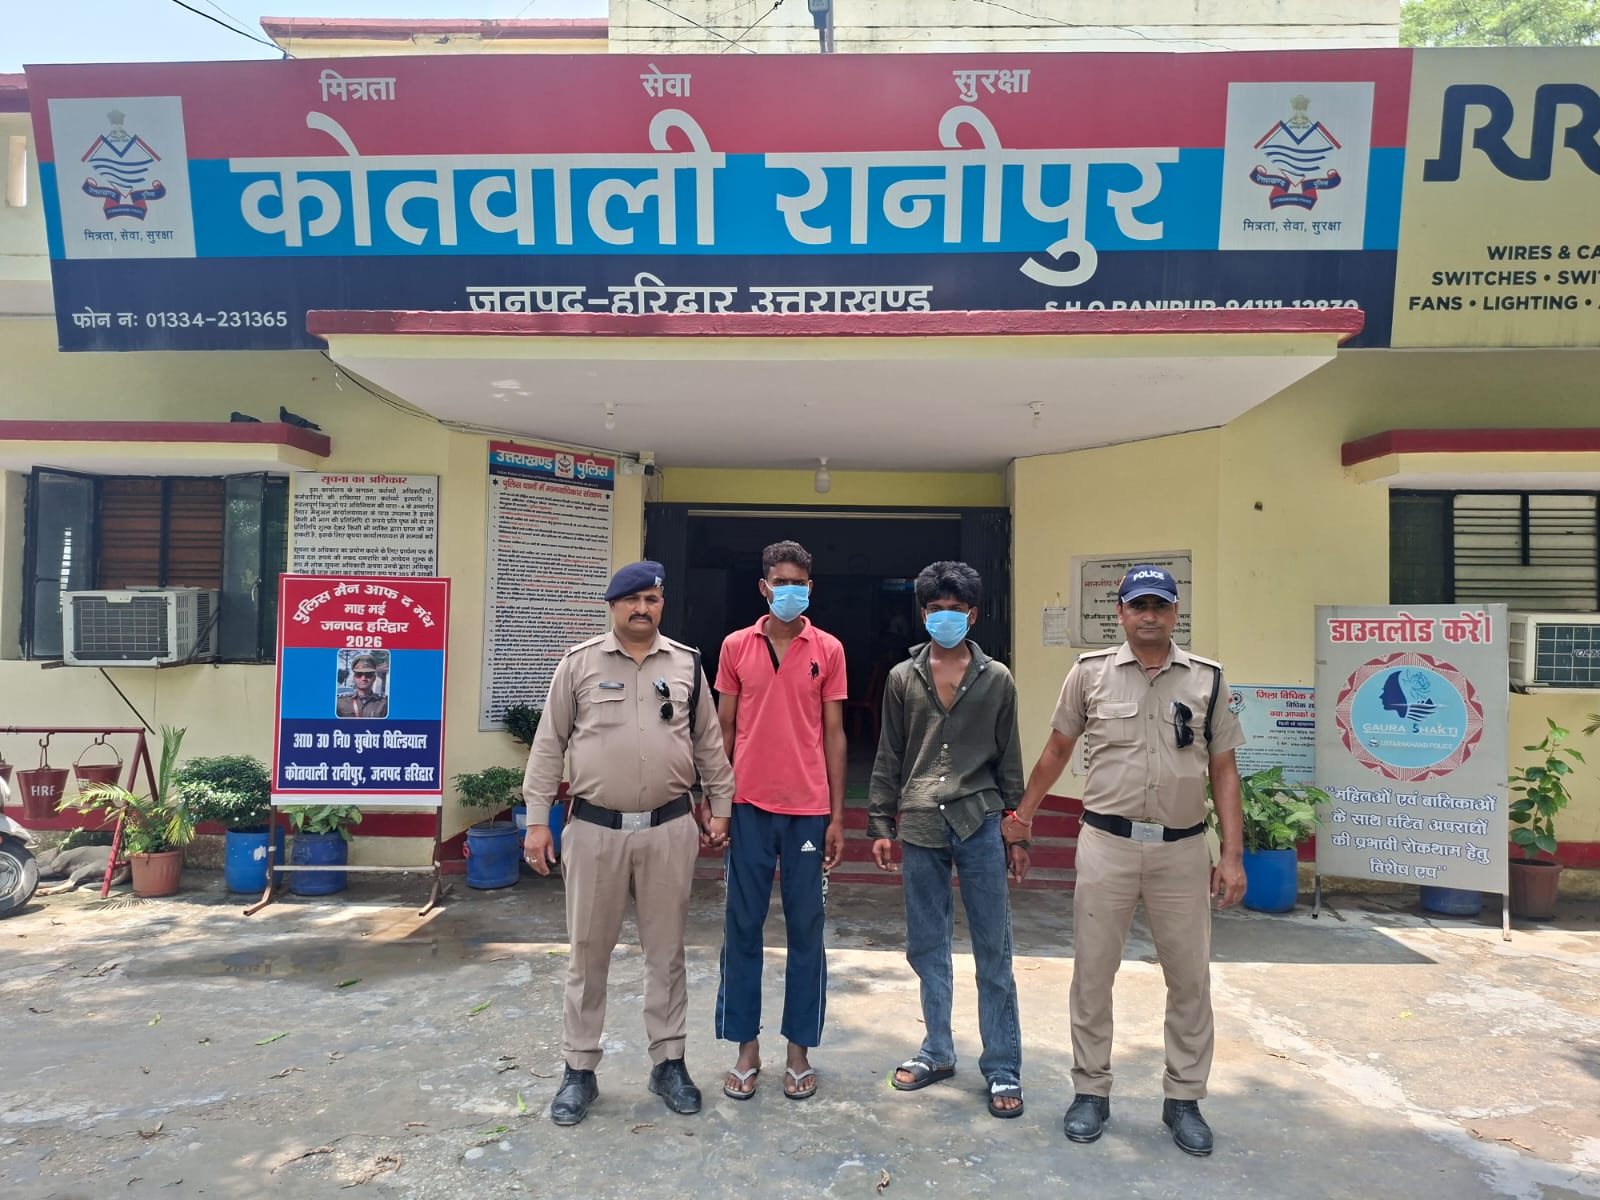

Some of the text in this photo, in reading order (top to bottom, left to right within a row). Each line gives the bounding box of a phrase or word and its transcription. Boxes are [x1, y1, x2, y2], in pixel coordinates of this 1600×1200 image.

[319, 70, 397, 102] मित्रता
[640, 63, 692, 98] सेवा
[952, 69, 1031, 103] सुरक्षा
[229, 105, 1180, 288] कोतवाली रानीपुर
[147, 230, 173, 244] सुरक्षा
[1243, 218, 1342, 235] मित्रता, सेवा, सुरक्षा
[1487, 245, 1552, 260] WIRES
[1558, 245, 1570, 259] &
[1432, 270, 1600, 286] SWITCHES SWI
[749, 285, 933, 313] उत्तराखण्ड
[1409, 295, 1578, 310] FANS LIGHTING
[72, 306, 111, 328] फोन
[146, 310, 288, 328] 01334-231365
[496, 449, 608, 479] उत्तराखण्ड पुलिस
[1133, 570, 1165, 581] POLICE
[292, 590, 331, 624] पुलिस
[401, 595, 414, 607] द
[344, 601, 387, 616] माह मई
[320, 618, 410, 633] जनपद हरिद्वार
[1328, 611, 1435, 643] डाउनलोड
[346, 635, 383, 648] 2026
[1363, 723, 1458, 735] GAURA SHAKTI
[285, 762, 434, 786] कोतवाली रानीपुर, जनपद हरिद्वार
[1396, 791, 1418, 806] एवं
[1421, 792, 1498, 812] बालिकाओं
[1332, 808, 1489, 836] के साथ घटित अपराधों
[1332, 831, 1491, 865] की प्रभावी रोकथाम हेतु
[1369, 857, 1409, 877] विशेष
